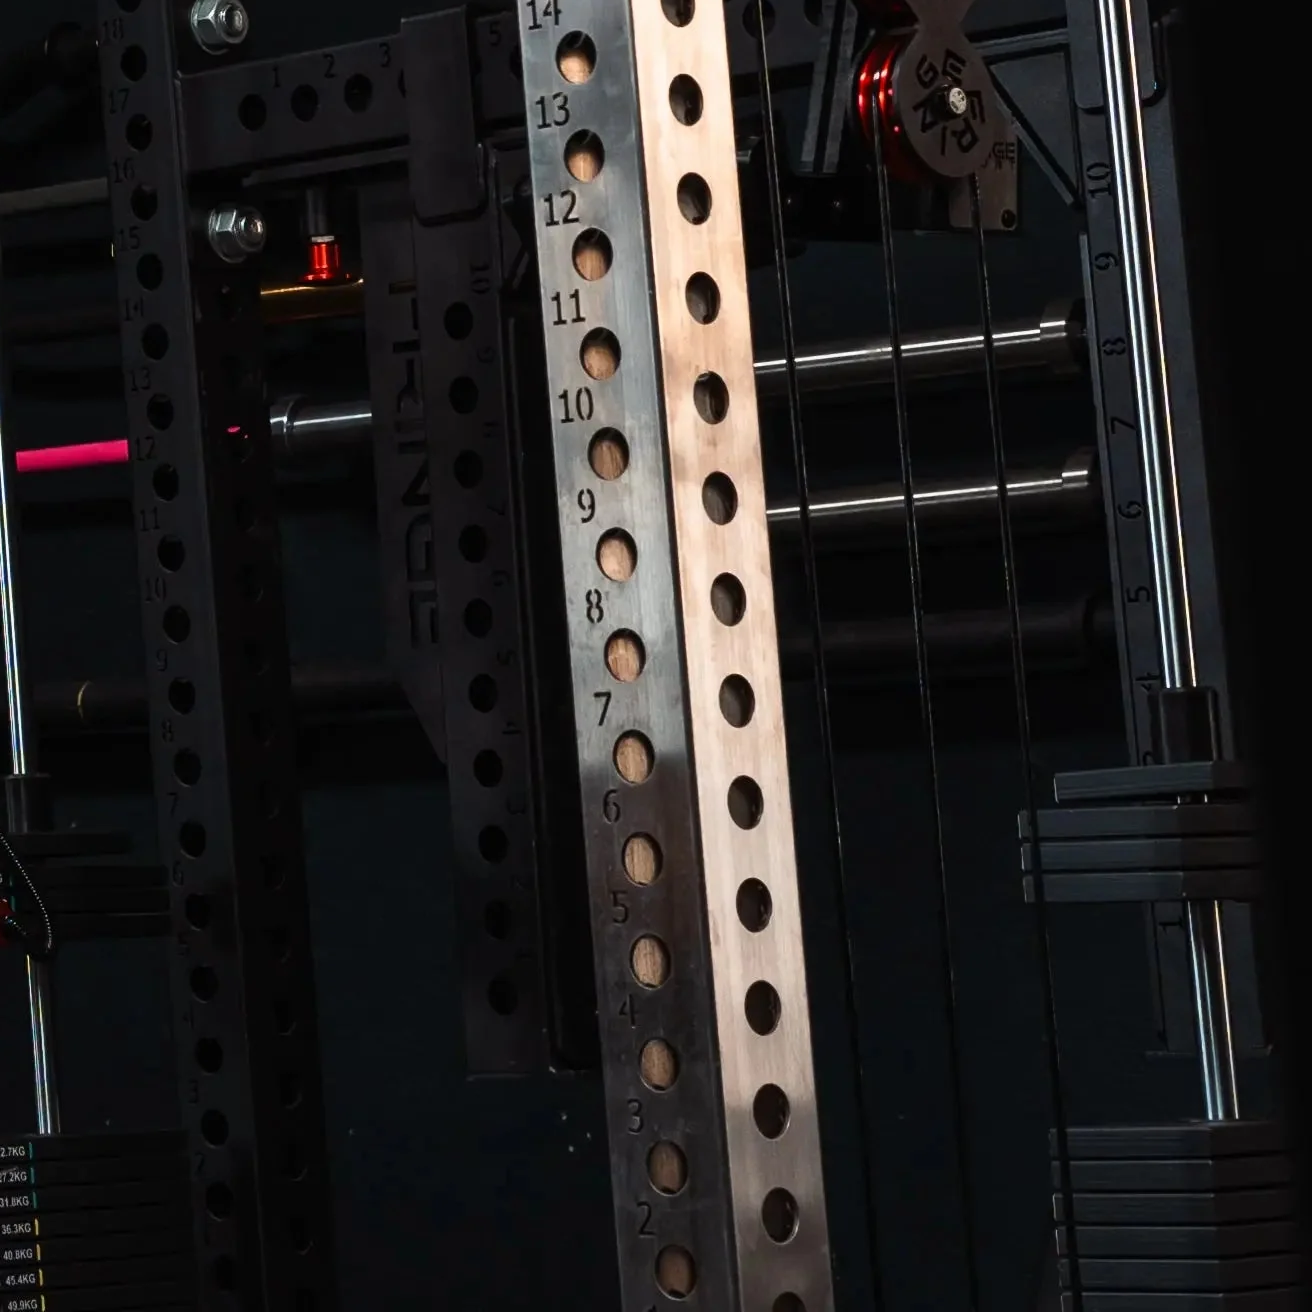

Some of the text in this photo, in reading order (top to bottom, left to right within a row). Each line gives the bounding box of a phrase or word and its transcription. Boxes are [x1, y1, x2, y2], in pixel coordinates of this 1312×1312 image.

[323, 53, 336, 78] 2
[379, 43, 391, 68] 3
[488, 23, 502, 46] 5
[535, 92, 570, 130] 13
[1086, 161, 1112, 199] 10
[543, 189, 580, 227] 12
[551, 288, 586, 326] 11
[1102, 337, 1127, 357] 8
[558, 386, 594, 424] 10
[577, 487, 596, 523] 9
[585, 588, 605, 624] 8
[1126, 585, 1152, 605] 5
[593, 691, 612, 726] 7
[602, 789, 621, 824] 6
[610, 891, 629, 925] 5
[626, 1099, 645, 1134] 3
[0, 1196, 30, 1208] 31.8KG
[636, 1201, 657, 1236] 2
[1, 1223, 32, 1235] 36.3KG
[3, 1248, 33, 1261] 40.8KG
[5, 1273, 36, 1286] 45.4KG
[7, 1299, 38, 1311] 49.9KG
